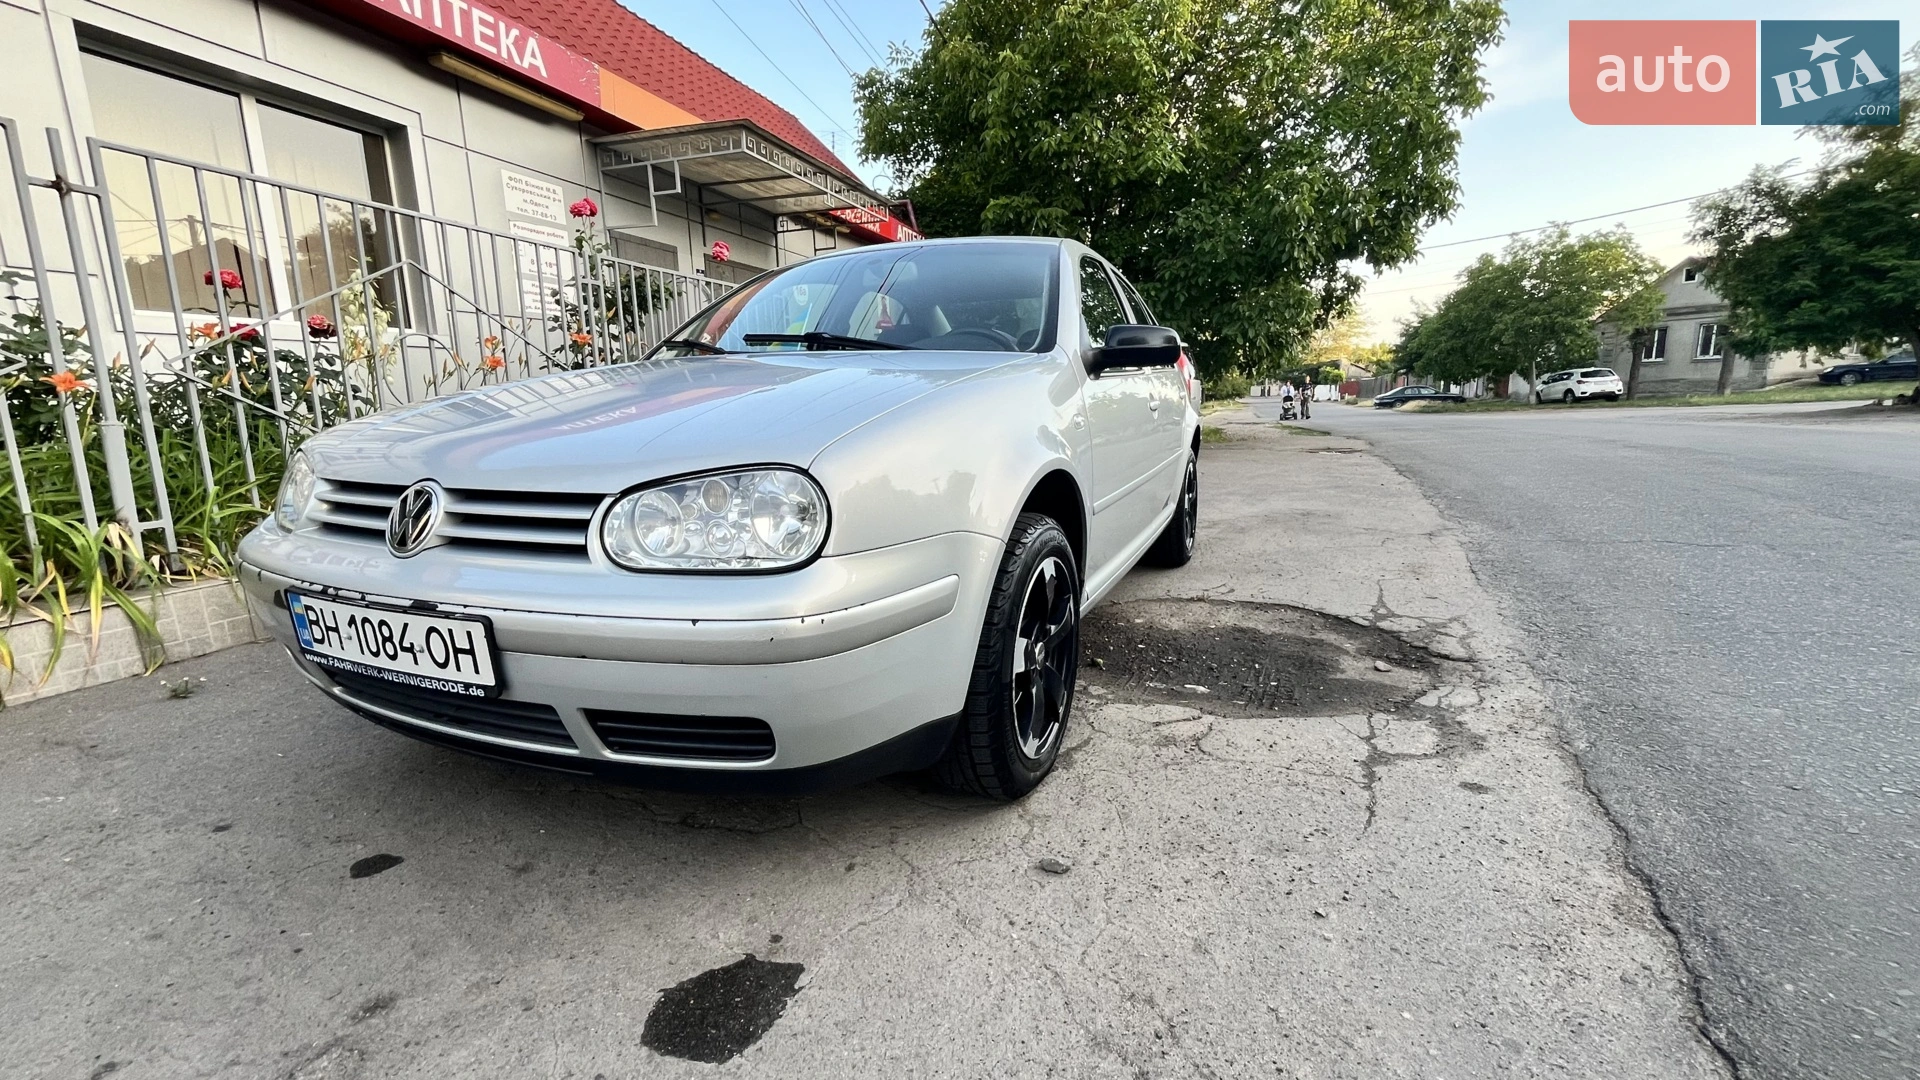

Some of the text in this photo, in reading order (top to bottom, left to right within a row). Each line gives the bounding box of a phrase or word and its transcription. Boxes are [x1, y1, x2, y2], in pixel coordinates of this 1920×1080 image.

[304, 604, 480, 675] BH 1084 OH
[304, 653, 485, 697] www.FAHRWERK-WERNIGERODE.de
